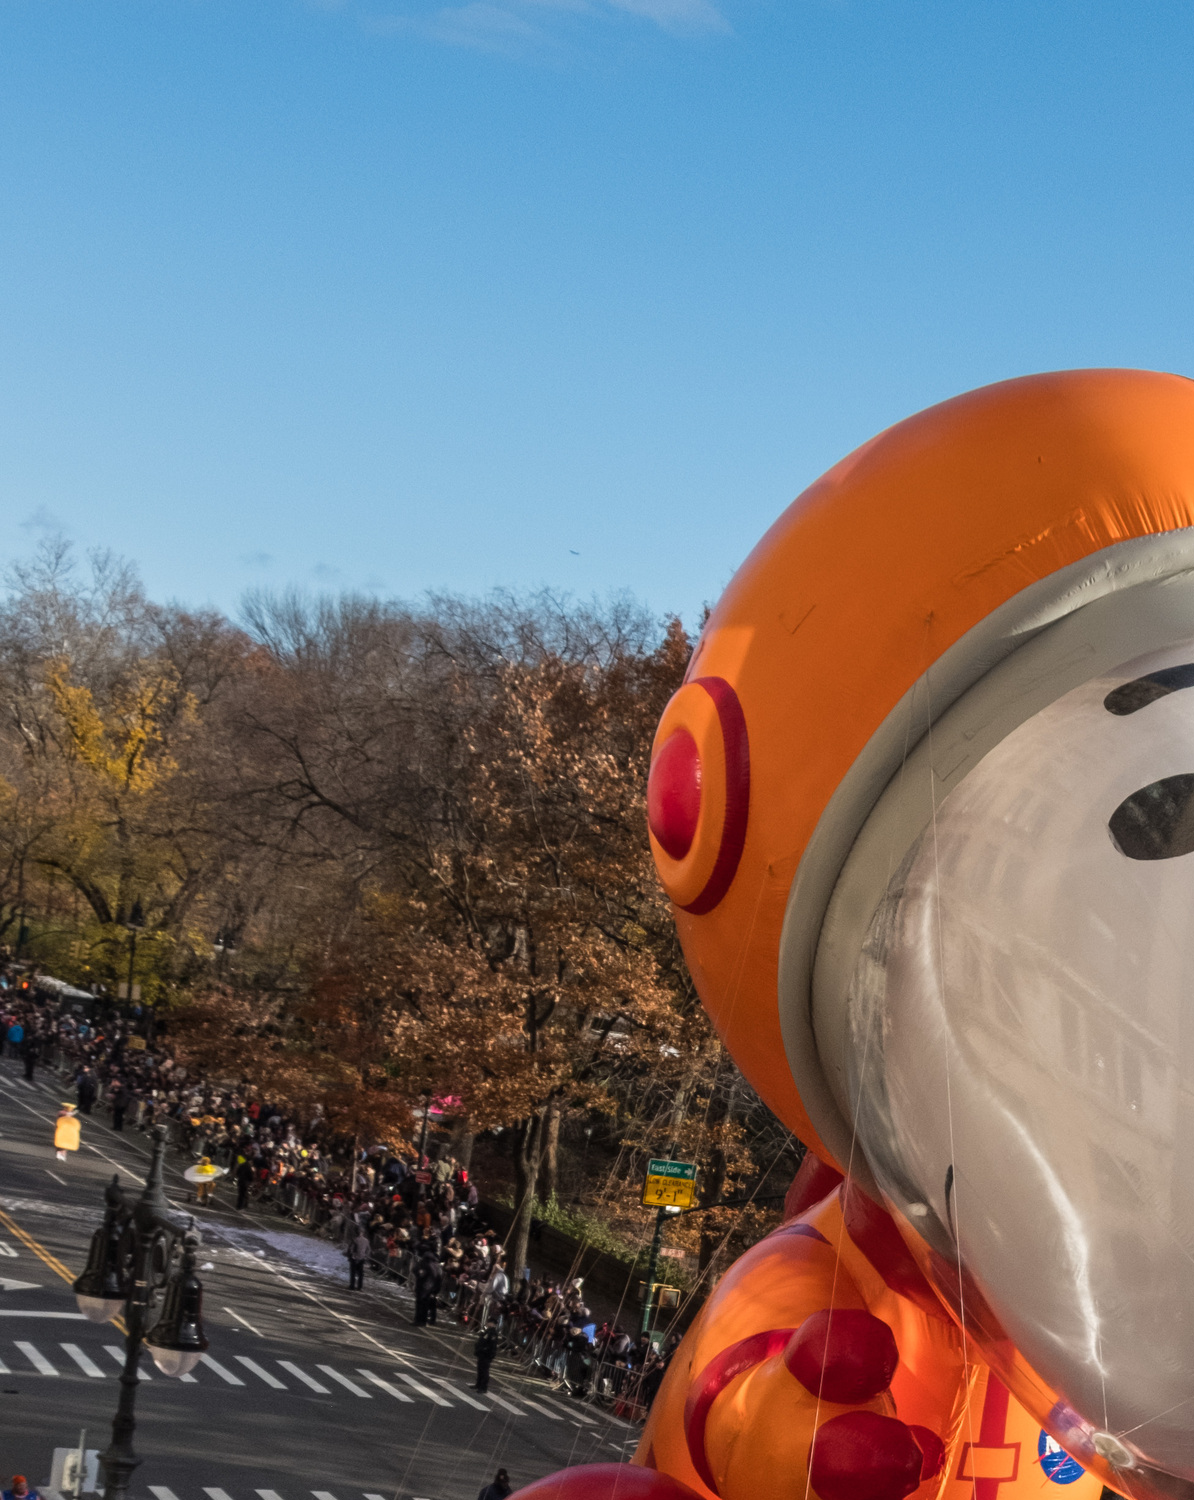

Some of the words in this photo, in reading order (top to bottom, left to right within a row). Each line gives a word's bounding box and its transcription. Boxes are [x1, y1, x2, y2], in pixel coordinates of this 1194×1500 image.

[651, 1164, 665, 1173] East
[667, 1166, 682, 1174] Side
[662, 1179, 692, 1189] CLEARANCE
